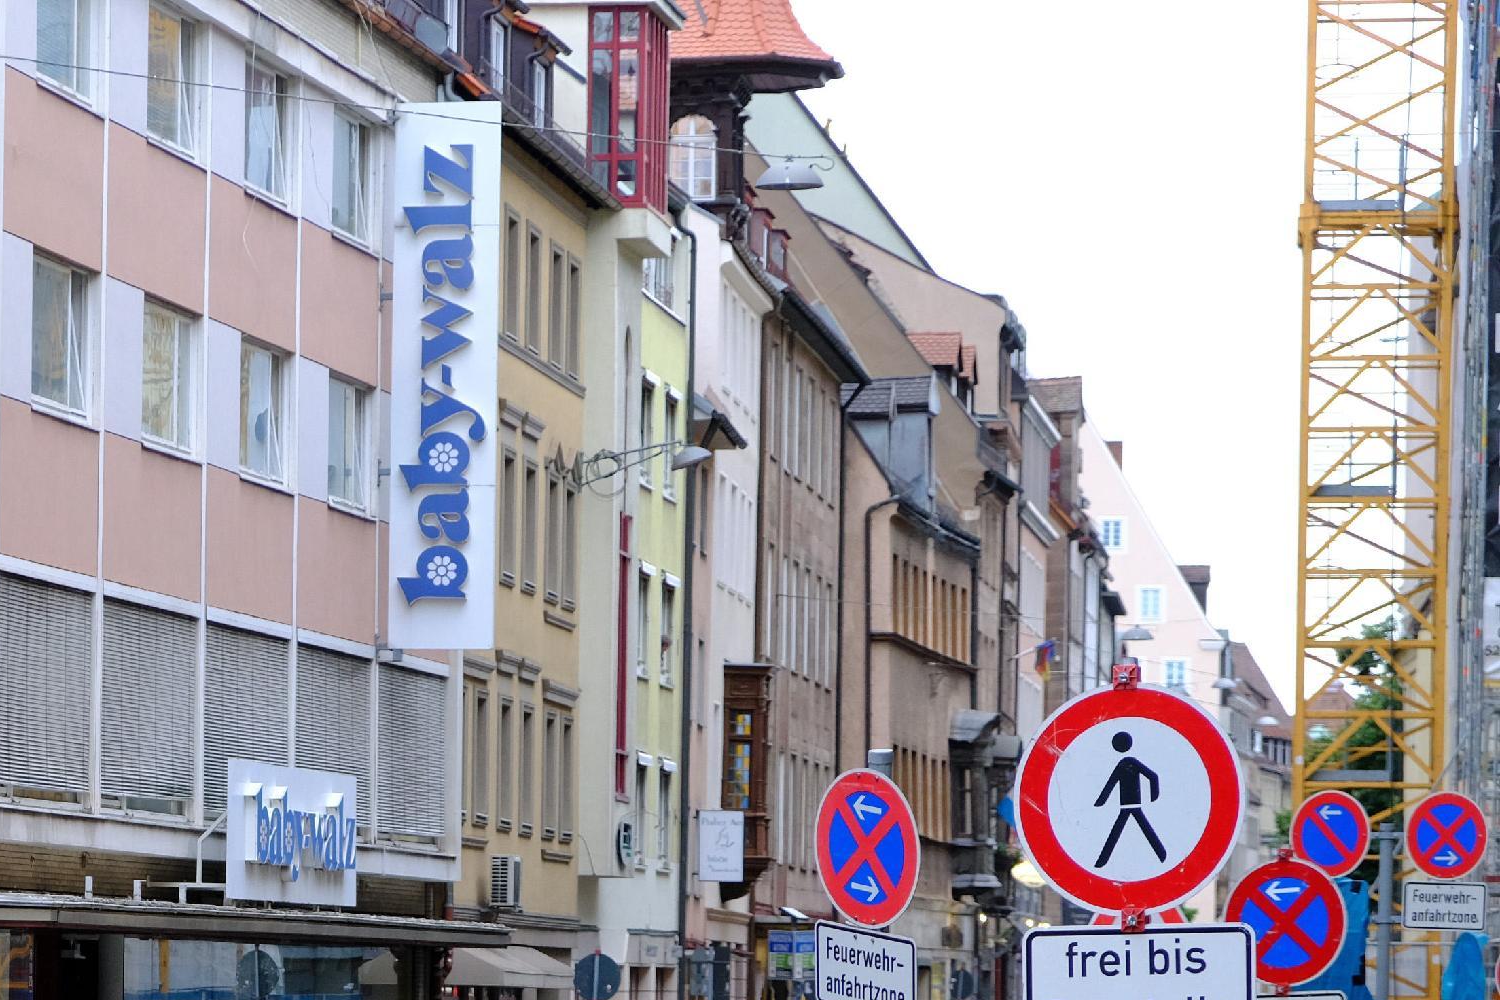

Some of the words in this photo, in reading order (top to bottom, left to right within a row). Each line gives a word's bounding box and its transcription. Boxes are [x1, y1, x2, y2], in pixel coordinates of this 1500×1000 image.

[398, 144, 488, 607] baby-walz
[250, 783, 357, 882] baby-walz
[1414, 889, 1477, 904] Feuerwehr-
[826, 936, 904, 973] Feuerwehr-
[1066, 939, 1131, 978] frei
[1148, 938, 1207, 975] bis
